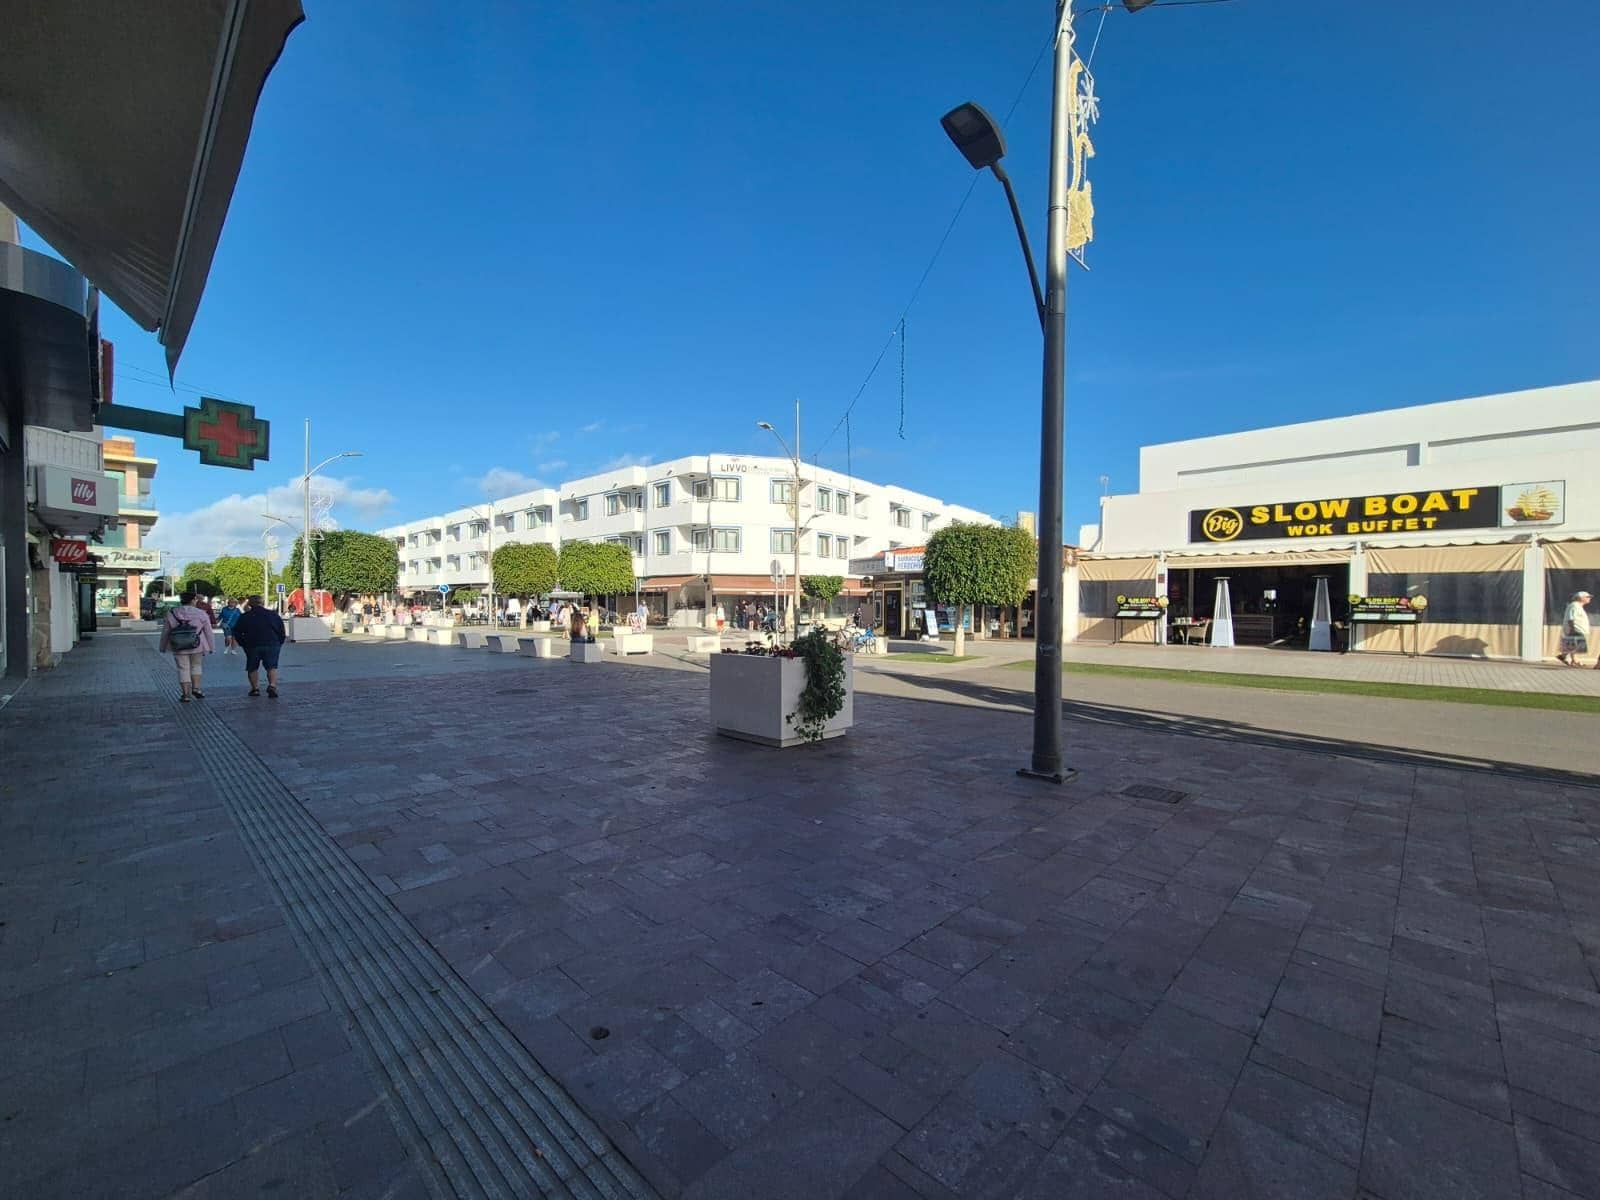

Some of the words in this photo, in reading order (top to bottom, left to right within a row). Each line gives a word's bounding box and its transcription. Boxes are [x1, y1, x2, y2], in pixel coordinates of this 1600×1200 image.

[74, 483, 94, 501] illy
[1251, 499, 1350, 524] SLOW
[1364, 489, 1478, 516] BOAT
[1209, 515, 1239, 534] Big
[1287, 523, 1333, 536] WOK
[1347, 517, 1437, 533] BUFFET
[56, 544, 85, 560] illy
